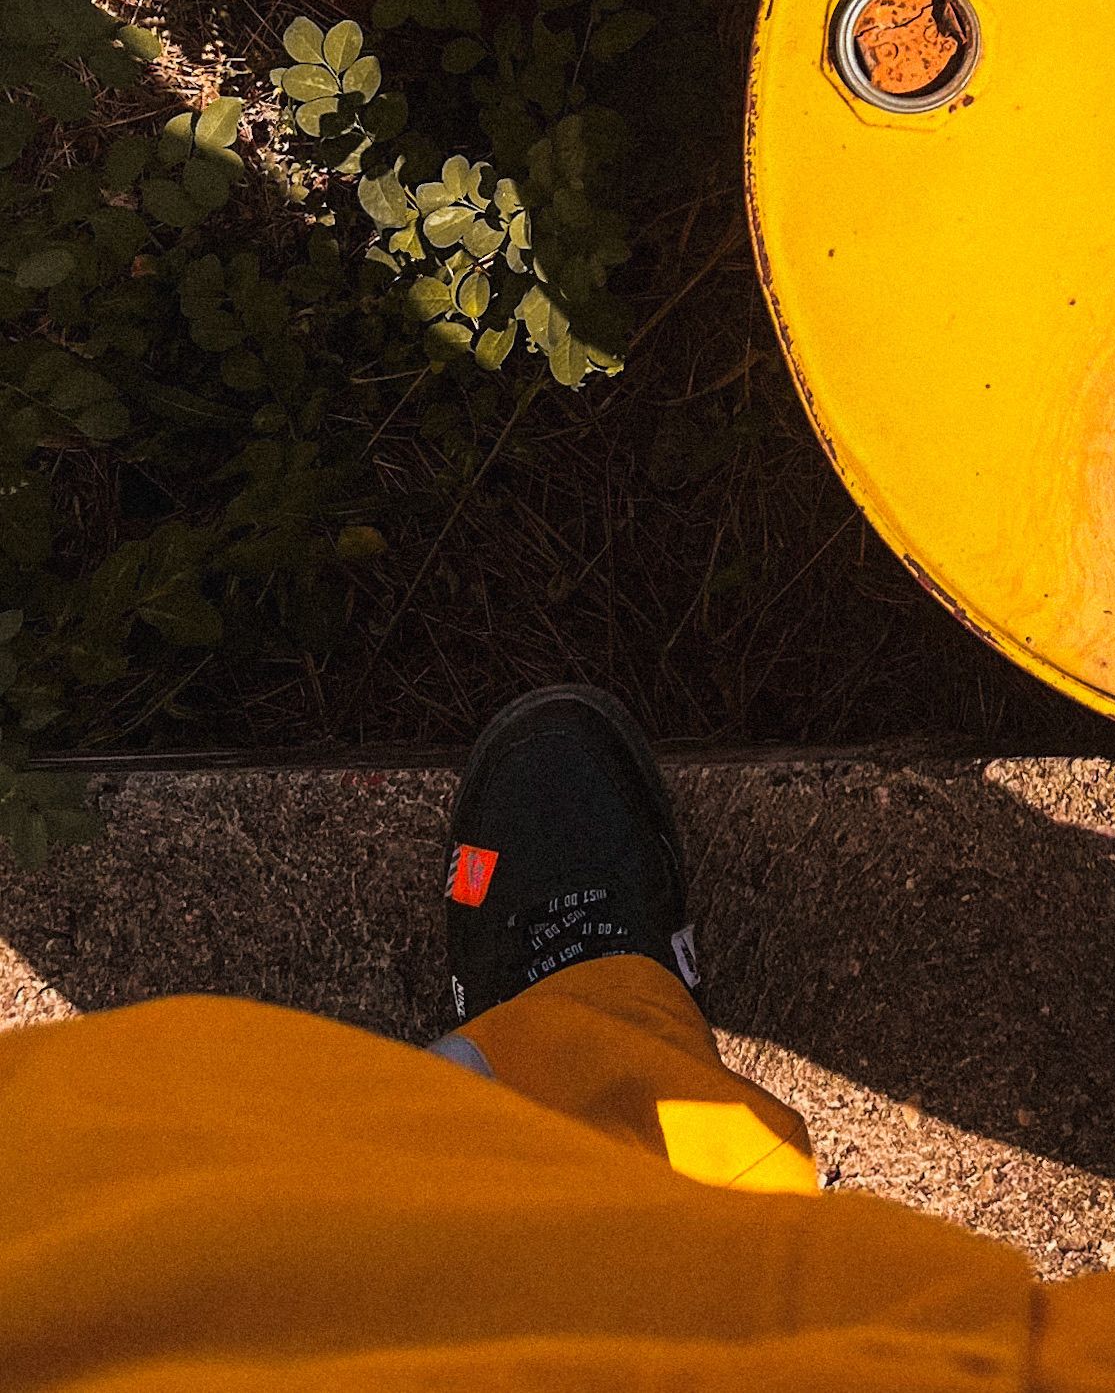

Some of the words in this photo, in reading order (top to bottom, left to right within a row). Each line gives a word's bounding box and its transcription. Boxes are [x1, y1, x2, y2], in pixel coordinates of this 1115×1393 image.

[563, 892, 577, 907] DO
[583, 888, 607, 903] JUST
[548, 897, 558, 912] IT
[562, 908, 586, 927] JUST
[544, 923, 560, 938] DO
[531, 936, 543, 950] IT
[559, 941, 584, 963] JUST
[541, 956, 556, 971] DO
[527, 967, 538, 982] IT
